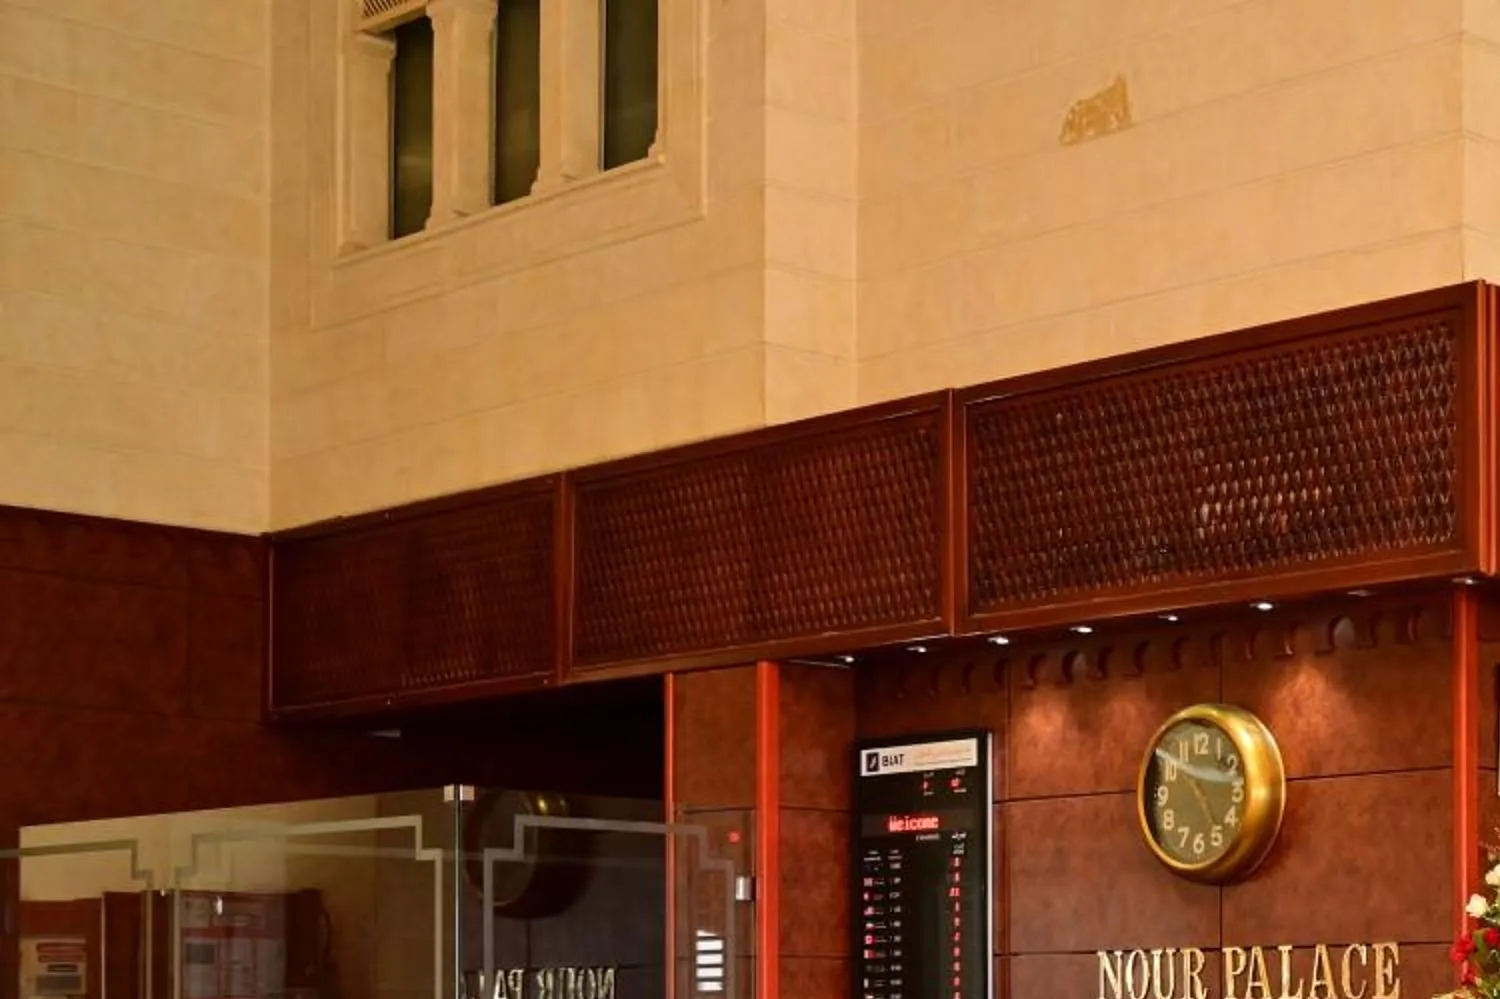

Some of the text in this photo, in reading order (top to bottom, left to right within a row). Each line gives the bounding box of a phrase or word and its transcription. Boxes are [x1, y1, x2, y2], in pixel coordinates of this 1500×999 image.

[1179, 741, 1189, 763] 11
[1193, 732, 1209, 755] 12
[1216, 737, 1222, 761] 1
[881, 754, 905, 767] BIAT
[1164, 756, 1177, 782] 10
[1226, 754, 1238, 777] 2
[1157, 785, 1169, 807] 9
[1231, 778, 1244, 803] 3
[1162, 809, 1175, 831] 8
[1223, 805, 1239, 828] 4
[1177, 826, 1190, 848] 7
[1193, 832, 1205, 855] 6
[1210, 824, 1223, 847] 5
